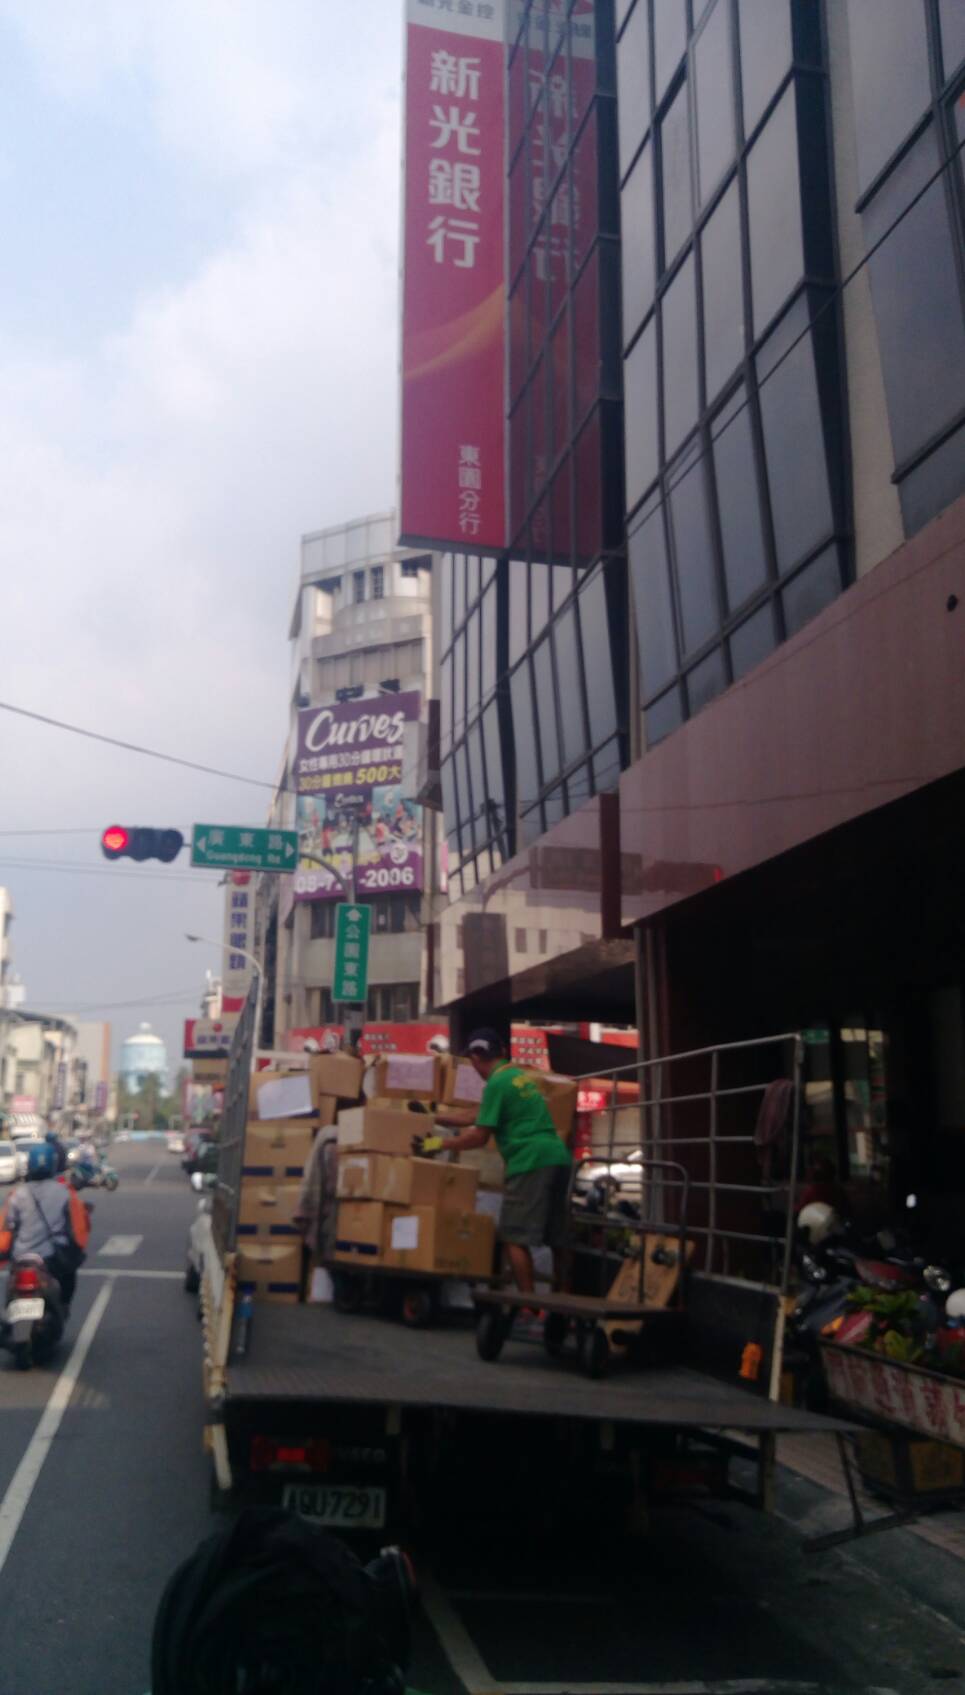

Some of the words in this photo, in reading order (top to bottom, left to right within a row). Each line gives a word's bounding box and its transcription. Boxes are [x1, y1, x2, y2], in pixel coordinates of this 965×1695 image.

[426, 49, 481, 269] 新光銀行
[305, 710, 406, 752] Curves
